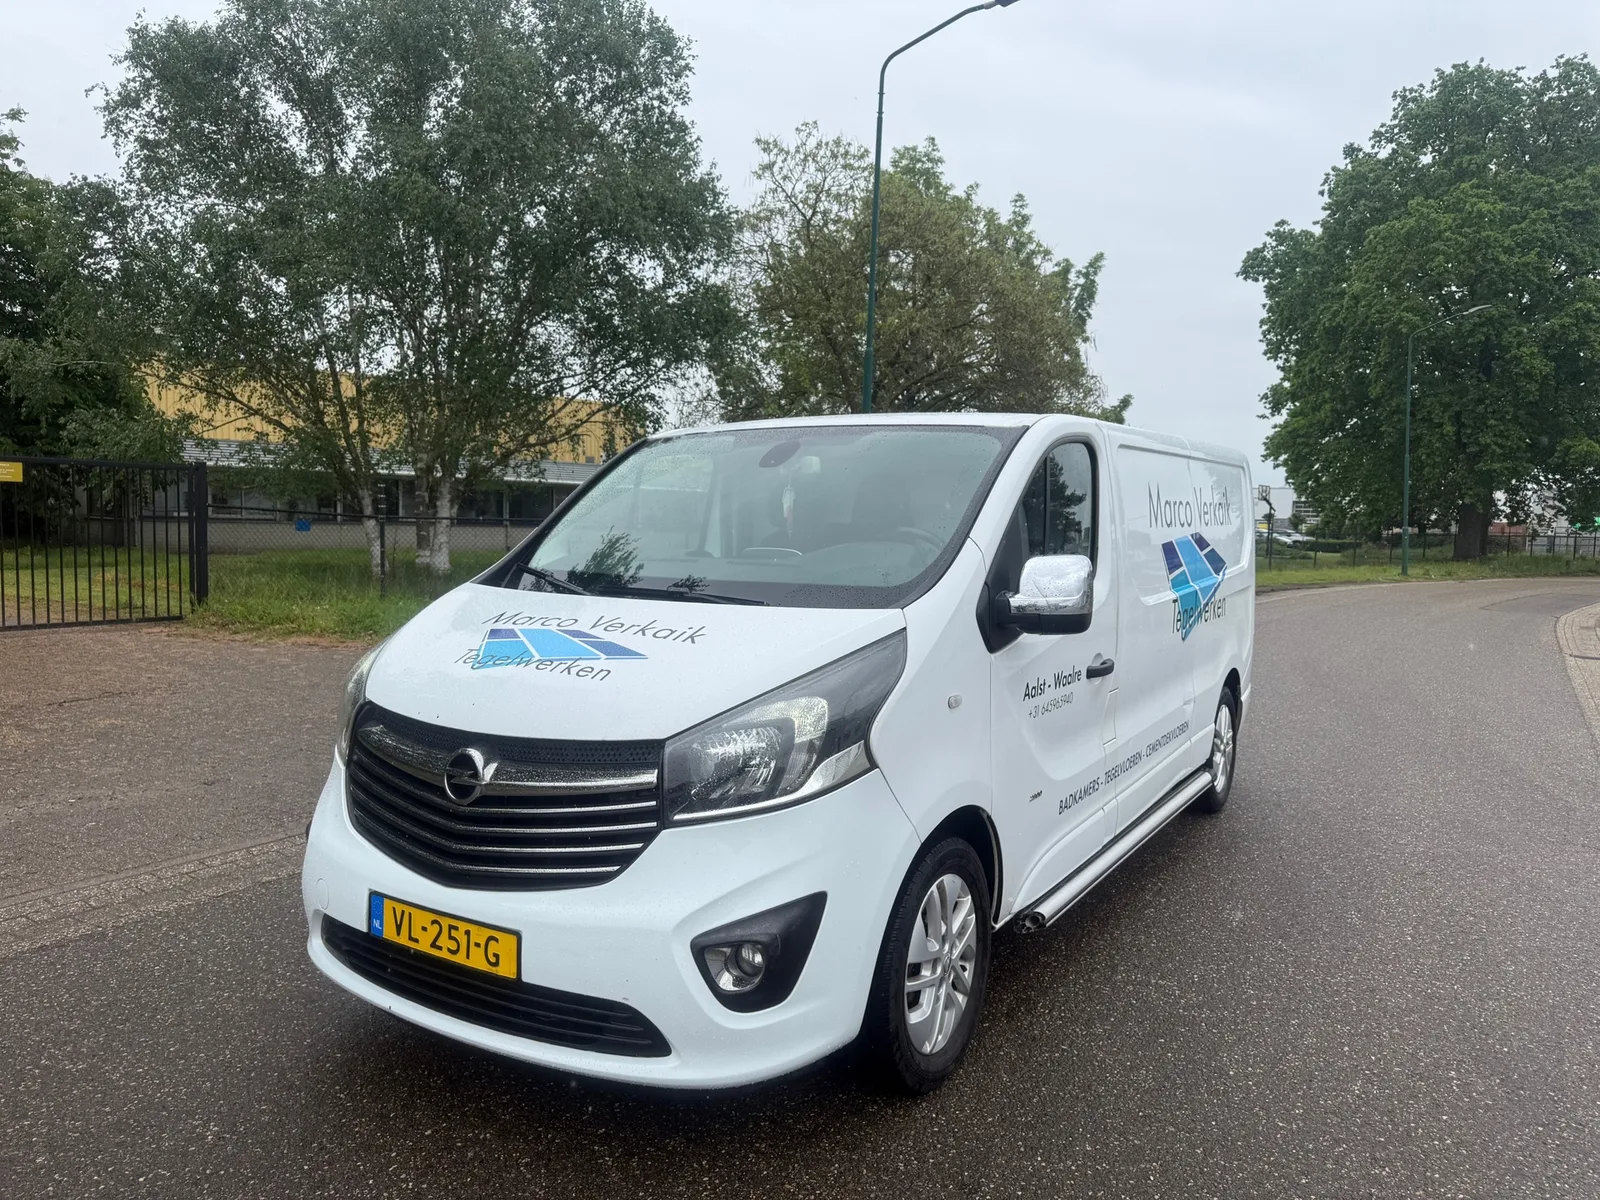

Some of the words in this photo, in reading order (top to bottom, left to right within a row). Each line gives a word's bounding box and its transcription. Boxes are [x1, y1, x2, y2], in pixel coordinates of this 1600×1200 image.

[1148, 481, 1193, 528] Marco
[1194, 485, 1232, 527] Verkaik
[482, 610, 579, 628] Marco
[589, 615, 708, 645] Verkaik
[1172, 594, 1226, 641] Tegelwerken
[454, 648, 612, 681] Tegelwerken
[1022, 676, 1046, 702] Aalst
[1053, 664, 1082, 690] Waalre
[1028, 704, 1040, 719] +31
[1058, 776, 1100, 815] BADKAMERS
[1104, 749, 1142, 786] TEGELVLOEREN
[373, 918, 382, 930] NL
[392, 906, 500, 968] VL-251-G
